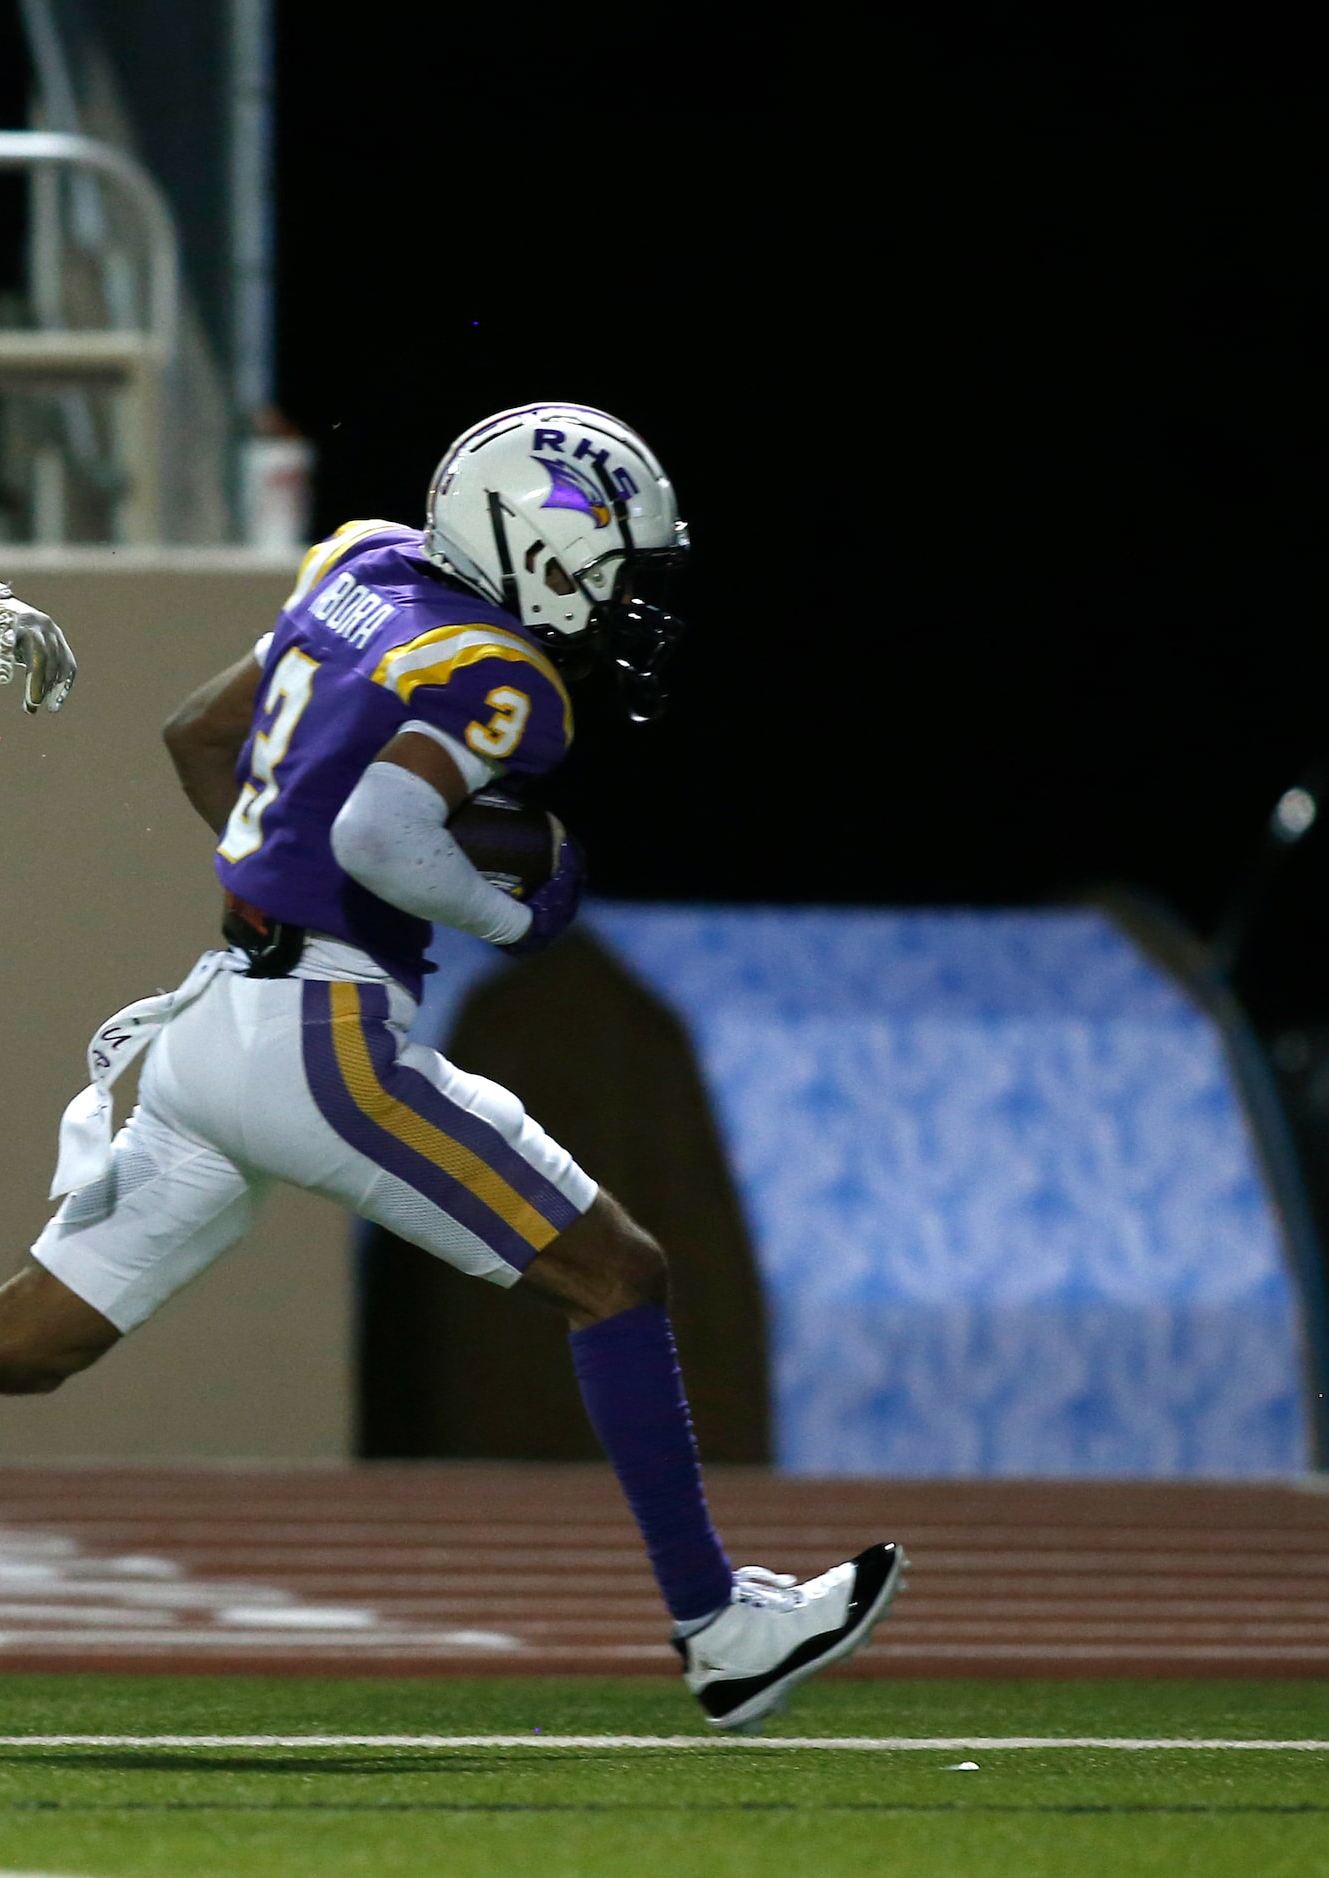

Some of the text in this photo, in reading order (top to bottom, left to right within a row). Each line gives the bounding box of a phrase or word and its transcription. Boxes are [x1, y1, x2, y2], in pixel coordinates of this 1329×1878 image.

[533, 428, 641, 503] RHS
[217, 646, 321, 864] 3
[465, 685, 532, 759] 3
